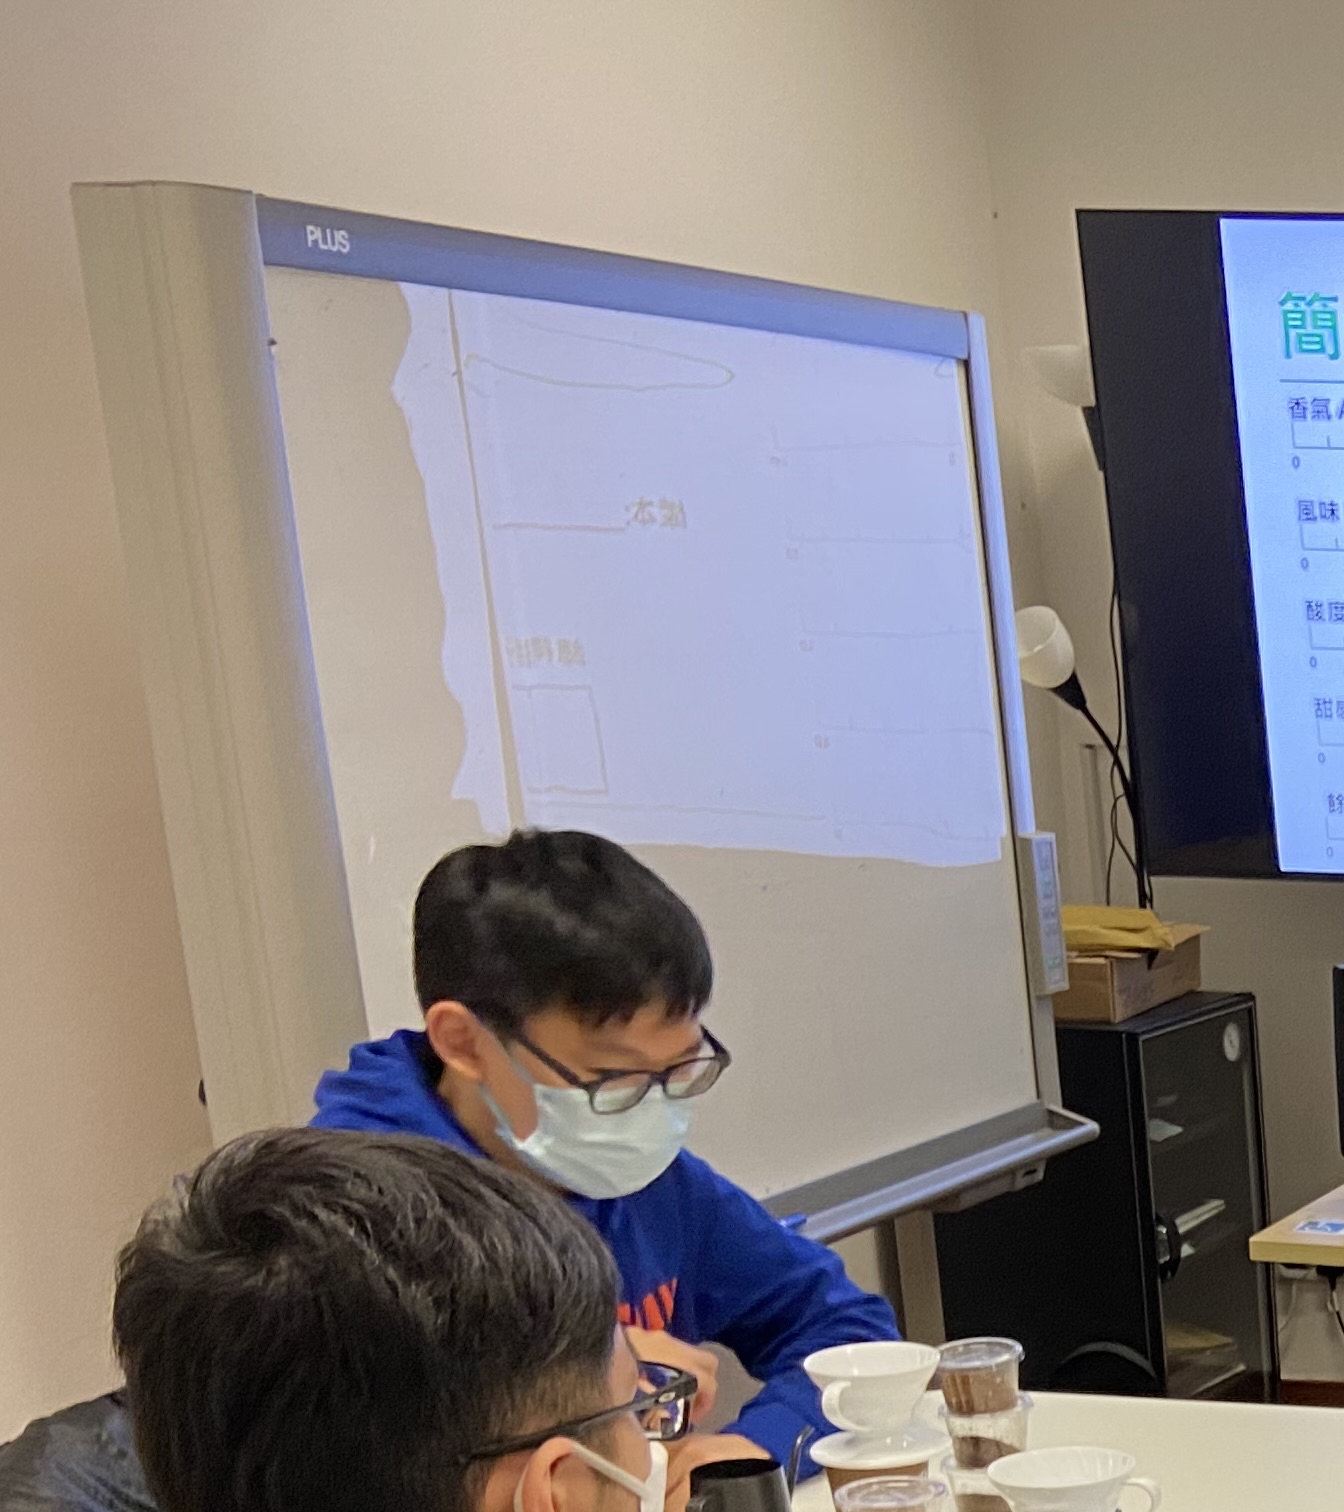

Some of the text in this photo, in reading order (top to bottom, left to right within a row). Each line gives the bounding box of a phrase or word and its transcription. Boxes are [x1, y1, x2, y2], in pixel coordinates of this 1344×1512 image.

[305, 225, 350, 253] PLUS
[1287, 396, 1333, 421] 香氣
[1291, 455, 1300, 470] 0
[1297, 500, 1340, 522] 風味
[1300, 557, 1309, 571] 0
[1309, 656, 1318, 669] 0
[1317, 752, 1326, 765] 0
[1326, 846, 1334, 859] 0
